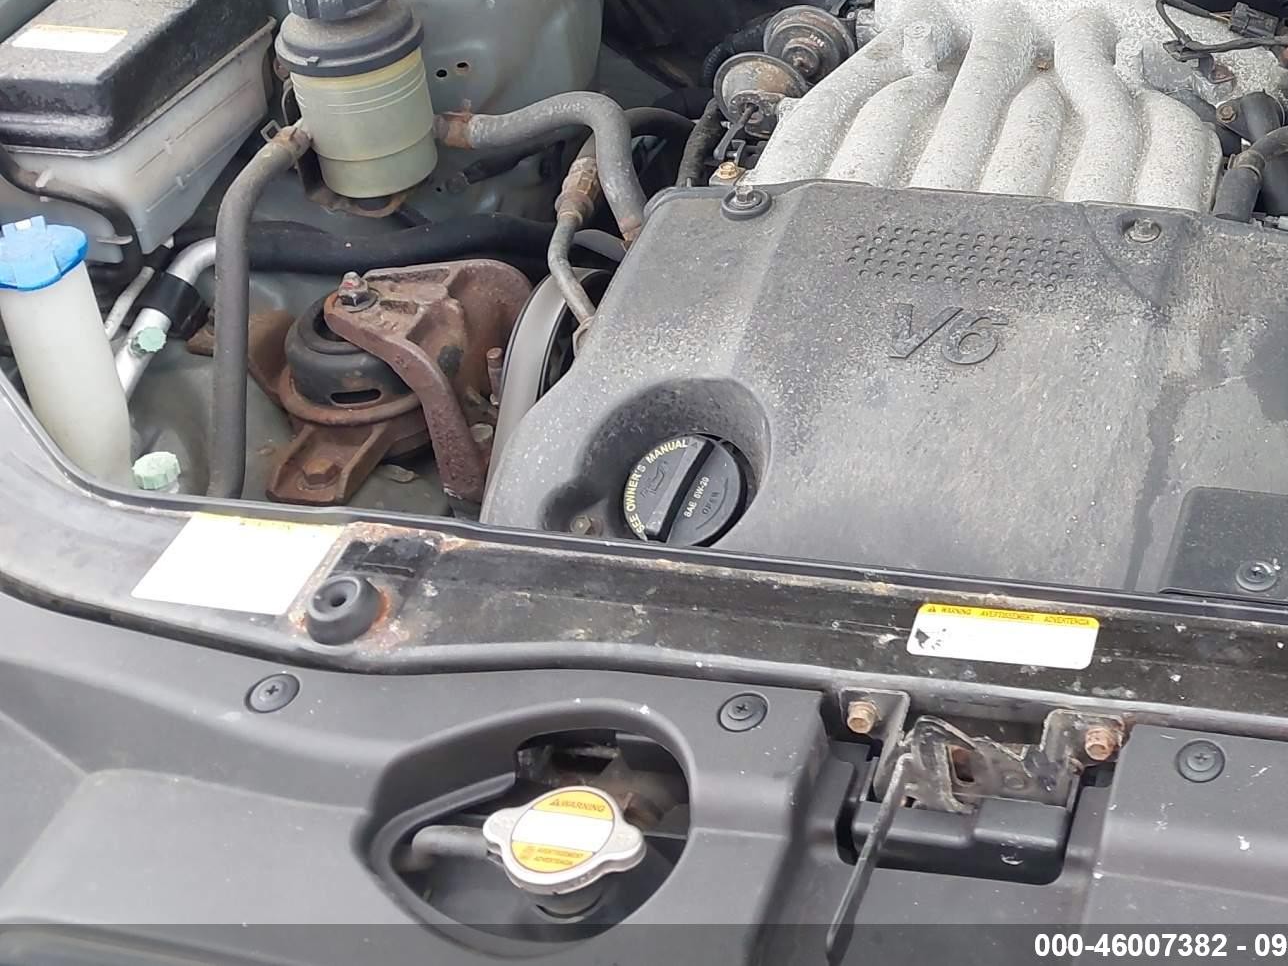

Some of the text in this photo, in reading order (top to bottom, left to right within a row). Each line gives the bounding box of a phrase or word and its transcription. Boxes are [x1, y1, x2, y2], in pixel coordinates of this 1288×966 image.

[889, 303, 1009, 366] V6
[625, 438, 689, 534] SEE OWNER'S MANUAL
[683, 476, 711, 518] SAE 5W-20
[940, 608, 972, 616] WARNING
[979, 610, 1035, 622] AVERTISSEMENT
[561, 799, 606, 812] WARNING
[537, 847, 584, 859] AVERTISSEMENT
